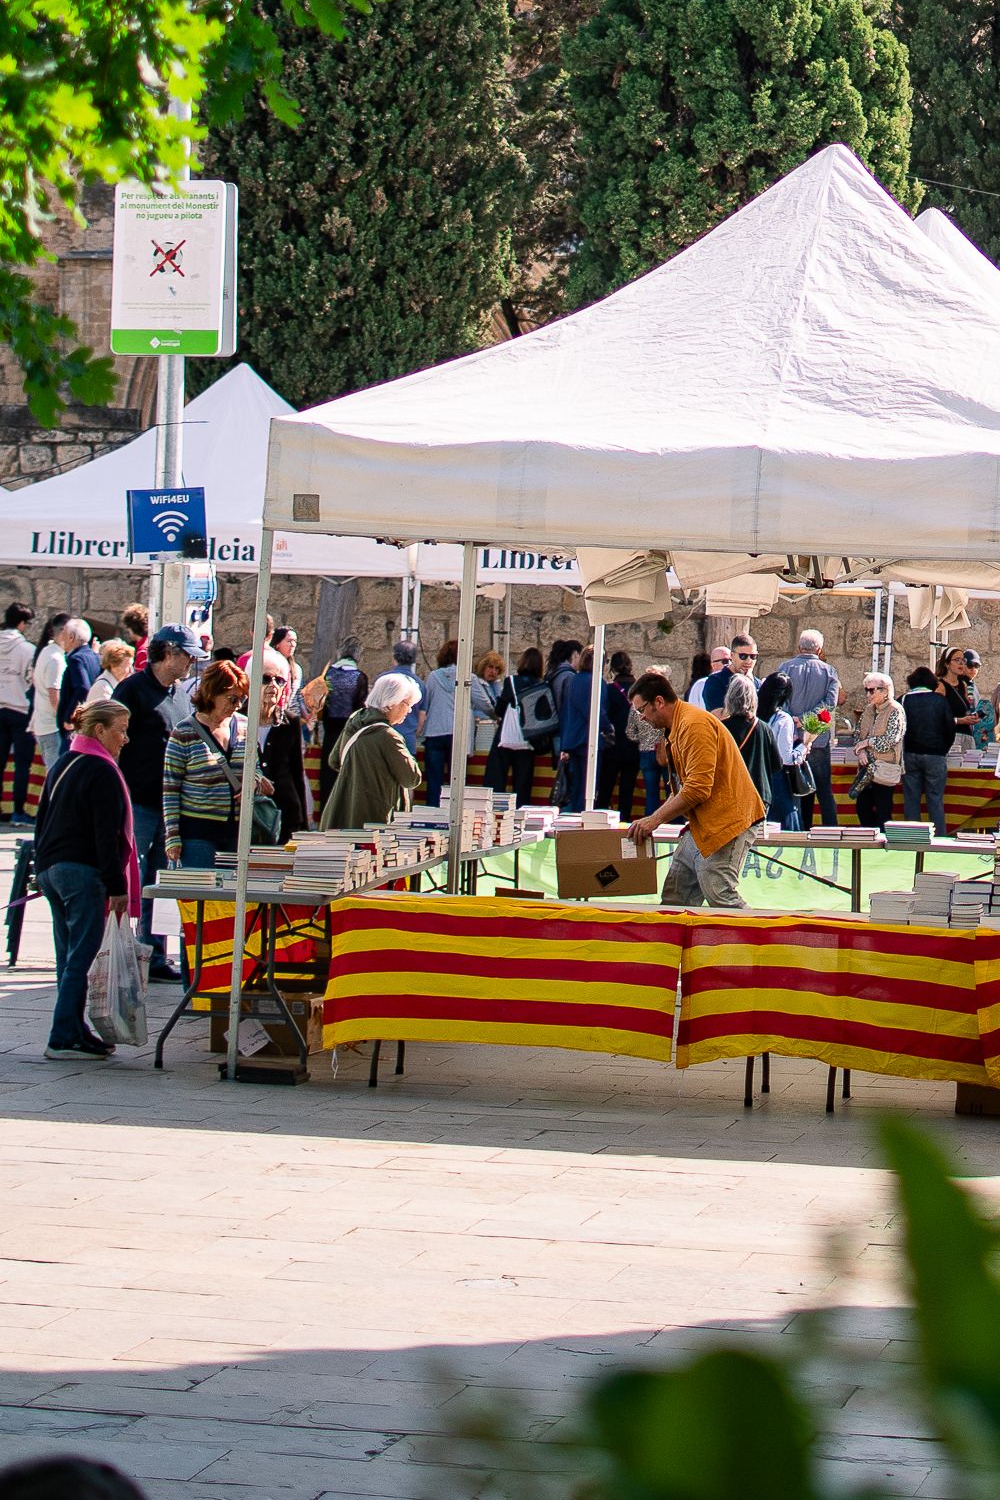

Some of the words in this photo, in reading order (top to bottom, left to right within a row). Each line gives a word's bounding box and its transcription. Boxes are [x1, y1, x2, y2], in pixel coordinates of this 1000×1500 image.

[121, 192, 134, 200] Per
[181, 191, 215, 200] ianants
[120, 202, 127, 210] al
[128, 202, 171, 210] monument
[172, 202, 184, 210] del
[185, 202, 219, 210] Monestir
[146, 212, 173, 220] jugueu
[180, 212, 203, 220] pilota
[150, 494, 190, 504] WiFi4EU
